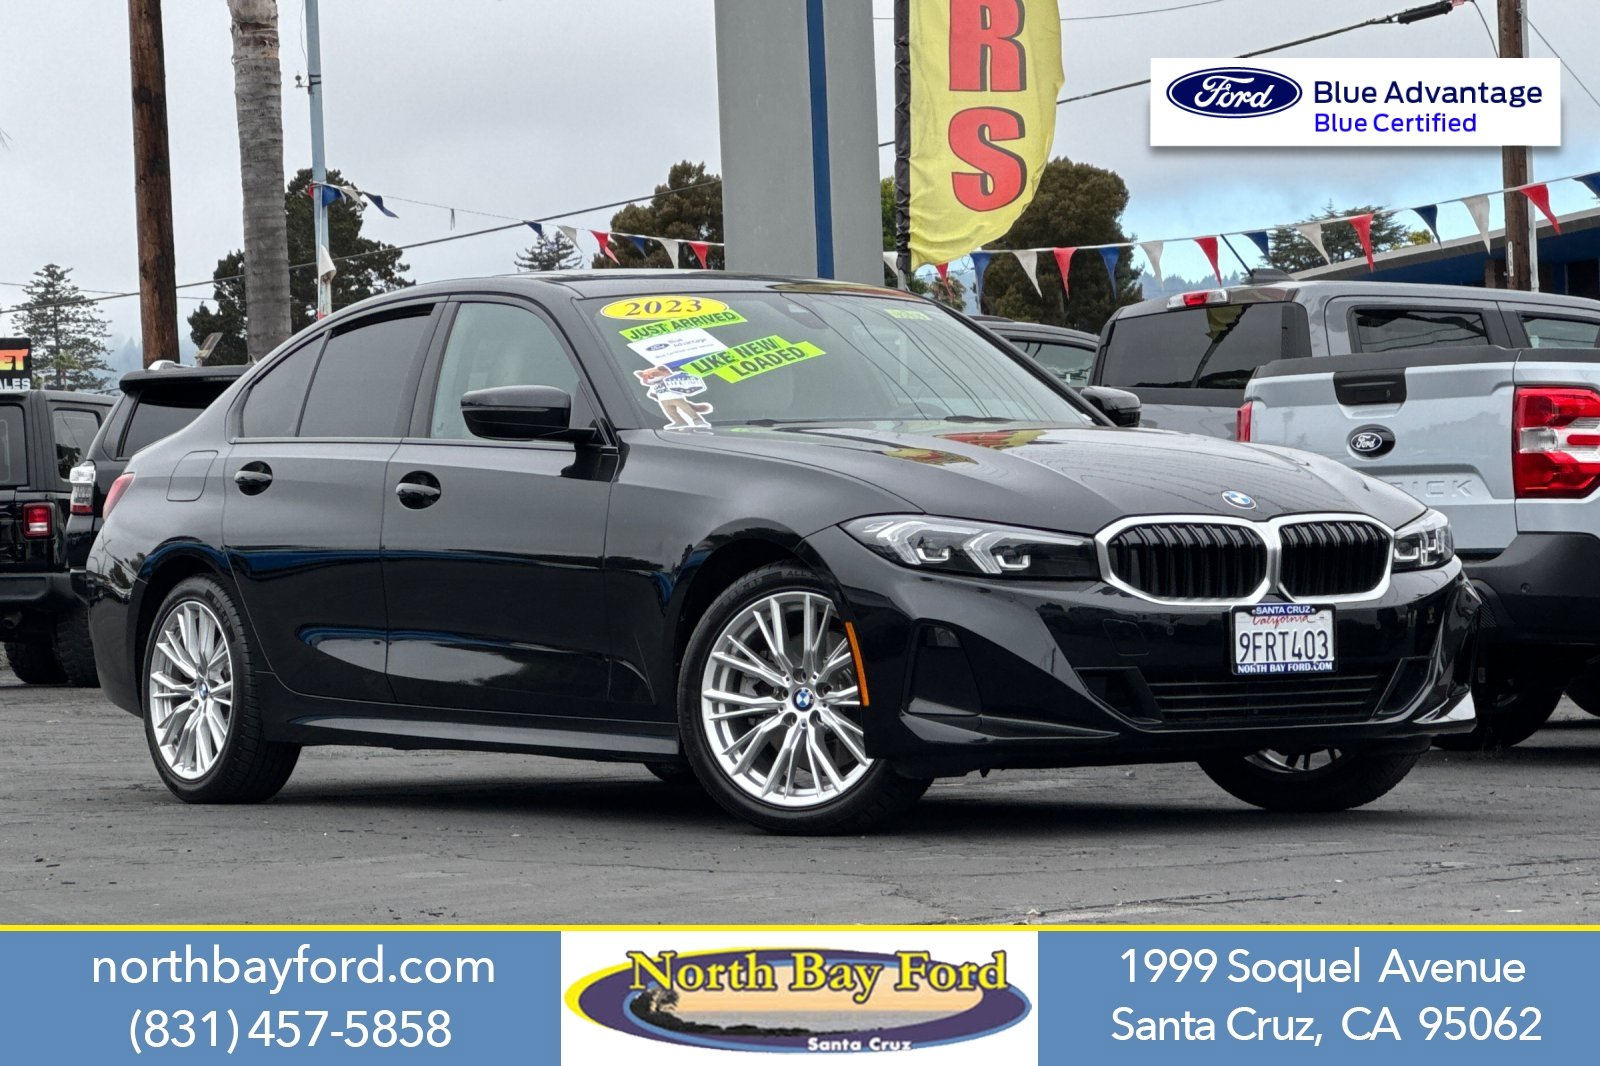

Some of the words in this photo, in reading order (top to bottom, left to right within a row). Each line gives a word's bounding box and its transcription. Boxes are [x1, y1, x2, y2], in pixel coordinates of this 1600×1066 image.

[624, 299, 703, 317] 2023
[629, 323, 668, 340] JUST
[670, 311, 738, 329] ARRIVED
[689, 351, 735, 374] LIKE
[733, 337, 779, 359] NEW
[728, 346, 806, 377] LOADED
[1355, 434, 1377, 449] Ford
[1255, 606, 1286, 615] SANTA
[1286, 605, 1311, 614] CRUZ
[1252, 614, 1314, 628] California
[1239, 630, 1329, 662] 9FRT403
[1237, 664, 1268, 674] NORTH
[1269, 663, 1286, 673] BAY
[1287, 662, 1333, 672] FORD.COM
